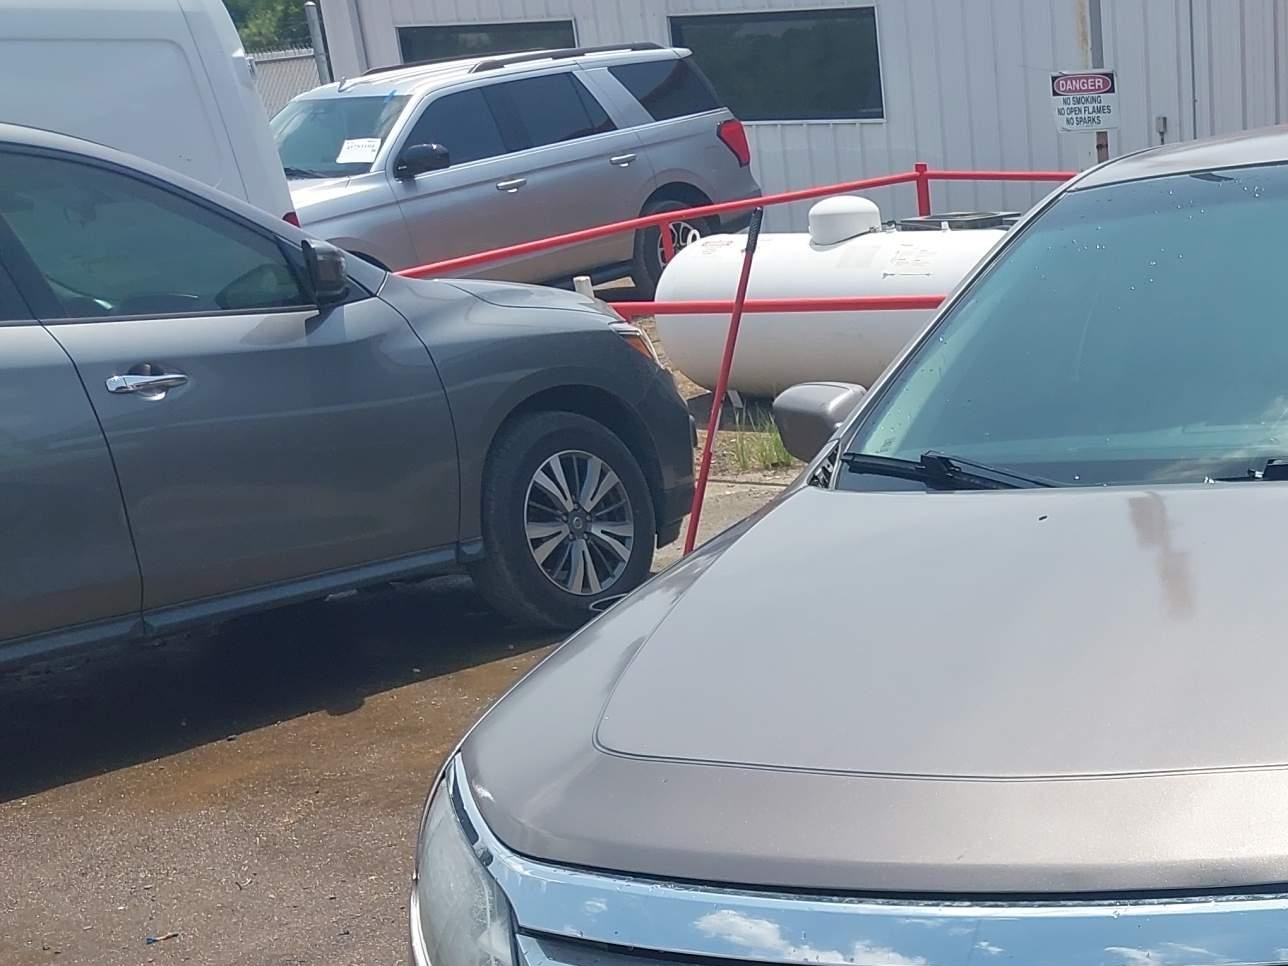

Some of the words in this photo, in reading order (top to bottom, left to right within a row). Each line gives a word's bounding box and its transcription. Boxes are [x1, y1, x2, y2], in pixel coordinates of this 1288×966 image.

[1059, 78, 1103, 91] DANGER
[1062, 97, 1071, 105] NO
[1072, 95, 1102, 105] SMOKING
[1057, 107, 1066, 116] NO
[1066, 106, 1082, 116] OPEN
[1084, 105, 1112, 115] FLAMES
[1066, 117, 1074, 125] NO
[1076, 116, 1101, 125] SPARKS
